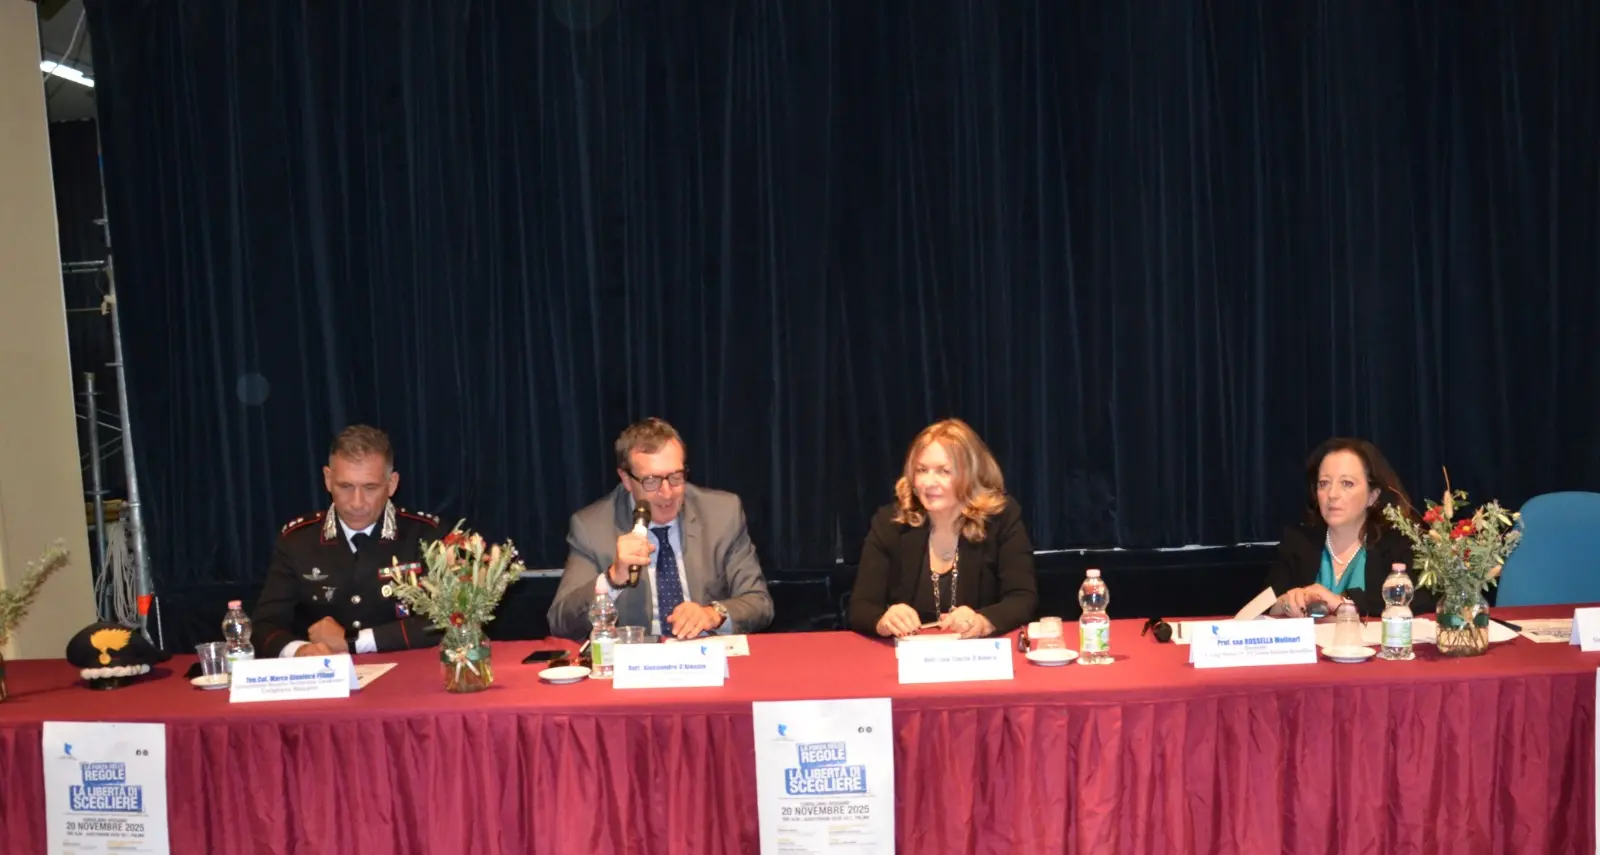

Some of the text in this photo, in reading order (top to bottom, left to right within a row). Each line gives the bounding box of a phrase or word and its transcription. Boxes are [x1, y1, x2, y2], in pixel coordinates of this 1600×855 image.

[1244, 636, 1274, 645] ROSSELLA
[801, 748, 845, 763] REGOLE
[84, 769, 125, 781] REGOLE
[789, 768, 804, 780] LA
[849, 766, 861, 778] DI
[789, 777, 862, 793] SCEGLIERE
[72, 786, 86, 797] LA
[127, 786, 138, 797] DI
[73, 796, 138, 810] SCEGLIERE
[781, 804, 870, 816] 20 NOVEMBRE 2025
[66, 821, 145, 832] 20 NOVEMBRE 2025
